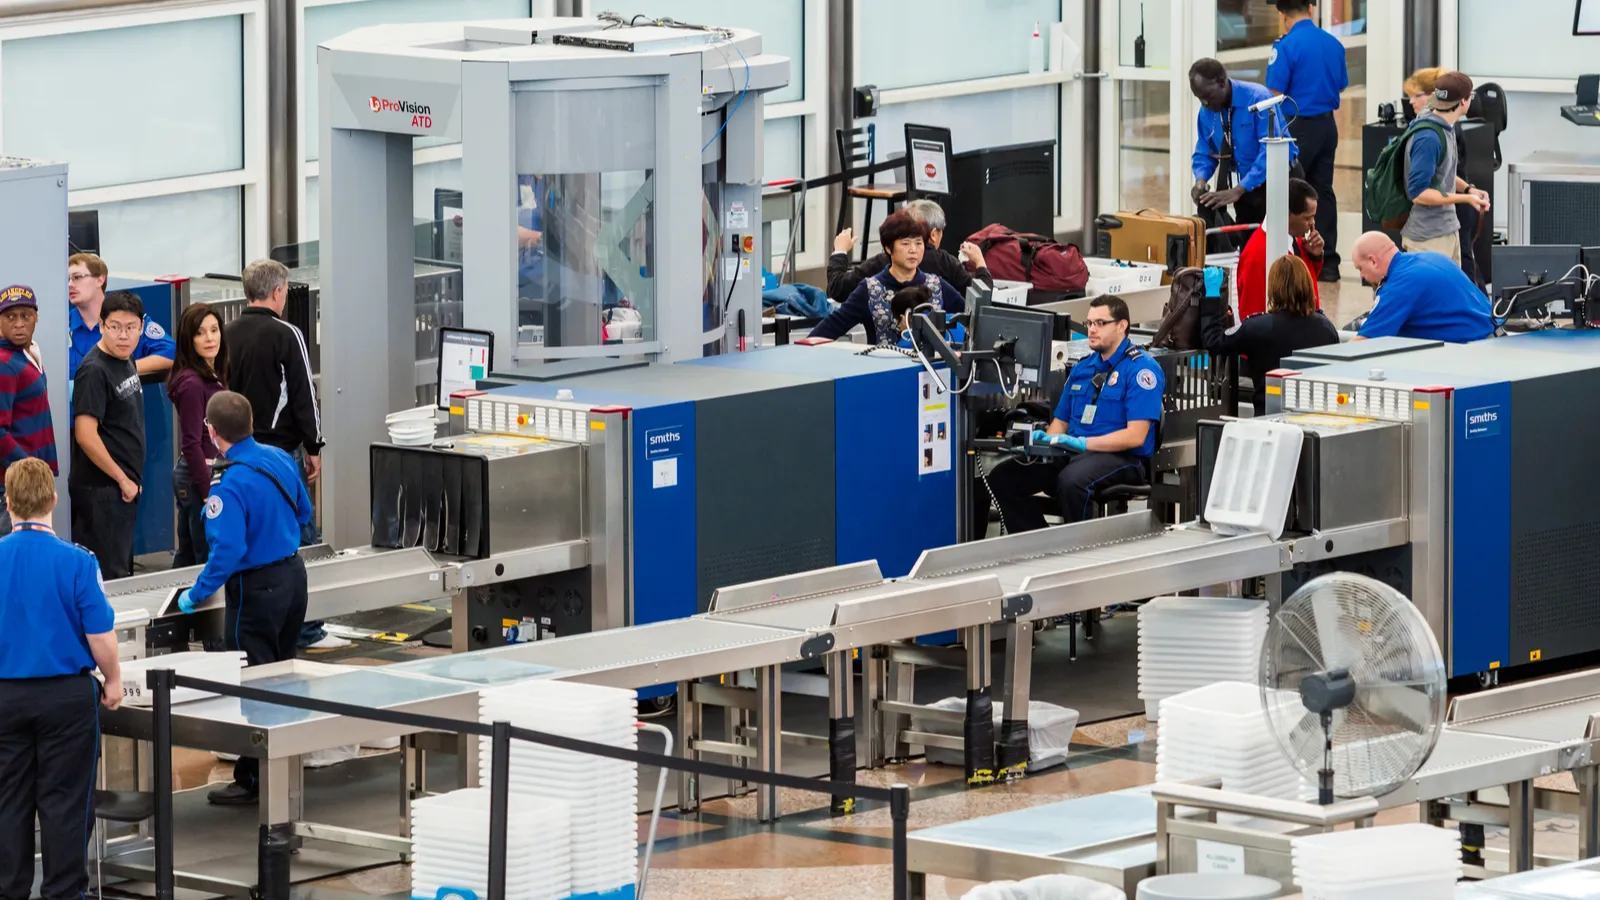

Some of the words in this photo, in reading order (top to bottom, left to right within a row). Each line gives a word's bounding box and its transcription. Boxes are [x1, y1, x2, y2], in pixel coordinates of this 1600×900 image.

[381, 98, 431, 115] ProVision
[411, 115, 432, 128] ATD
[7, 287, 33, 300] ANGELES
[1469, 411, 1498, 425] smiths
[649, 431, 681, 445] smiths
